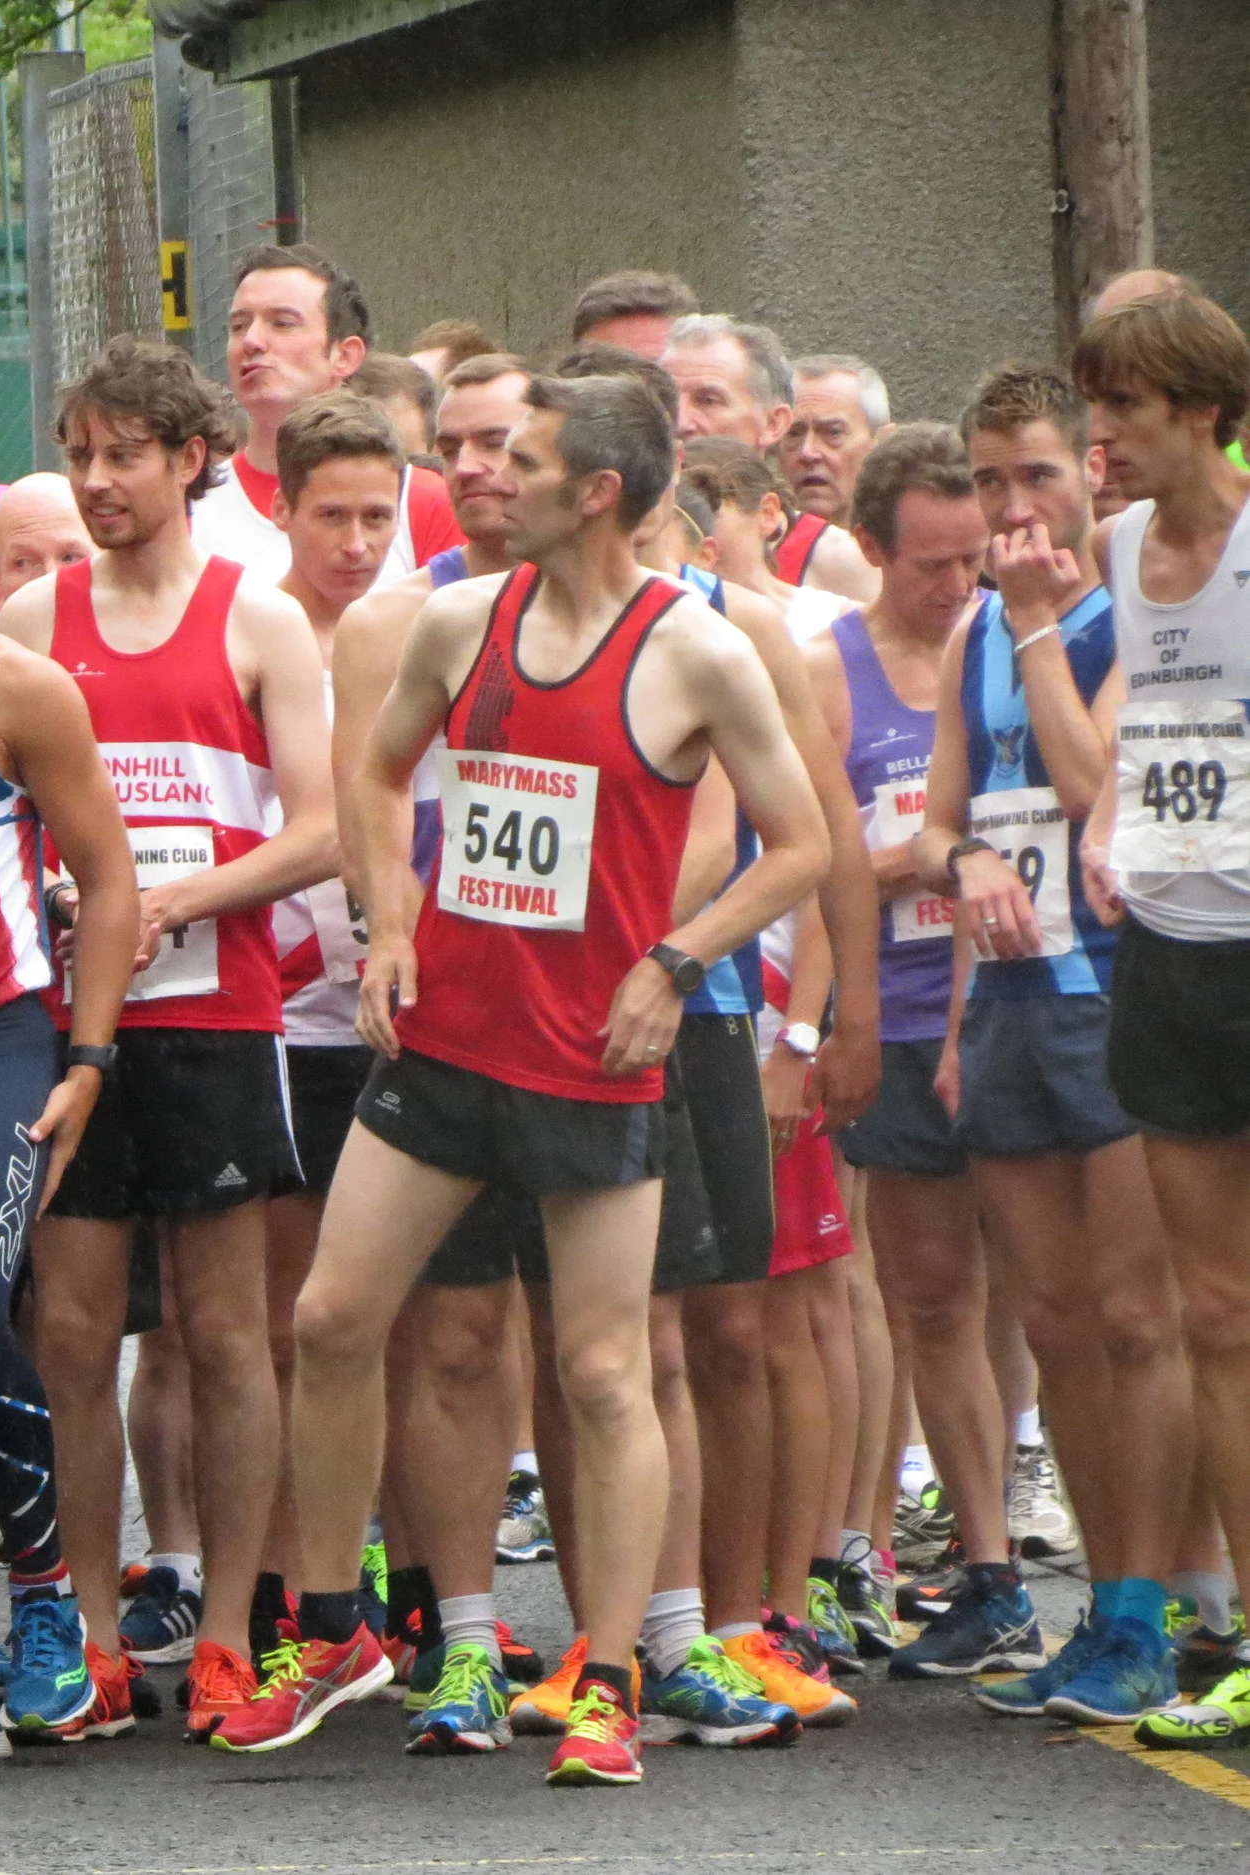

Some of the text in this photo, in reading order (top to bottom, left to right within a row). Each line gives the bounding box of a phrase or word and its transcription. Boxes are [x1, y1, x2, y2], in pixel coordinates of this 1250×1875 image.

[1152, 627, 1191, 645] CITY
[1160, 648, 1181, 664] OF
[1130, 664, 1223, 689] EDINBURGH
[456, 759, 579, 799] MARYMASS
[1142, 760, 1227, 823] 489
[464, 802, 560, 876] 540
[172, 848, 208, 863] CLUB
[457, 874, 559, 917] FESTIVAL
[214, 1176, 248, 1188] adidas
